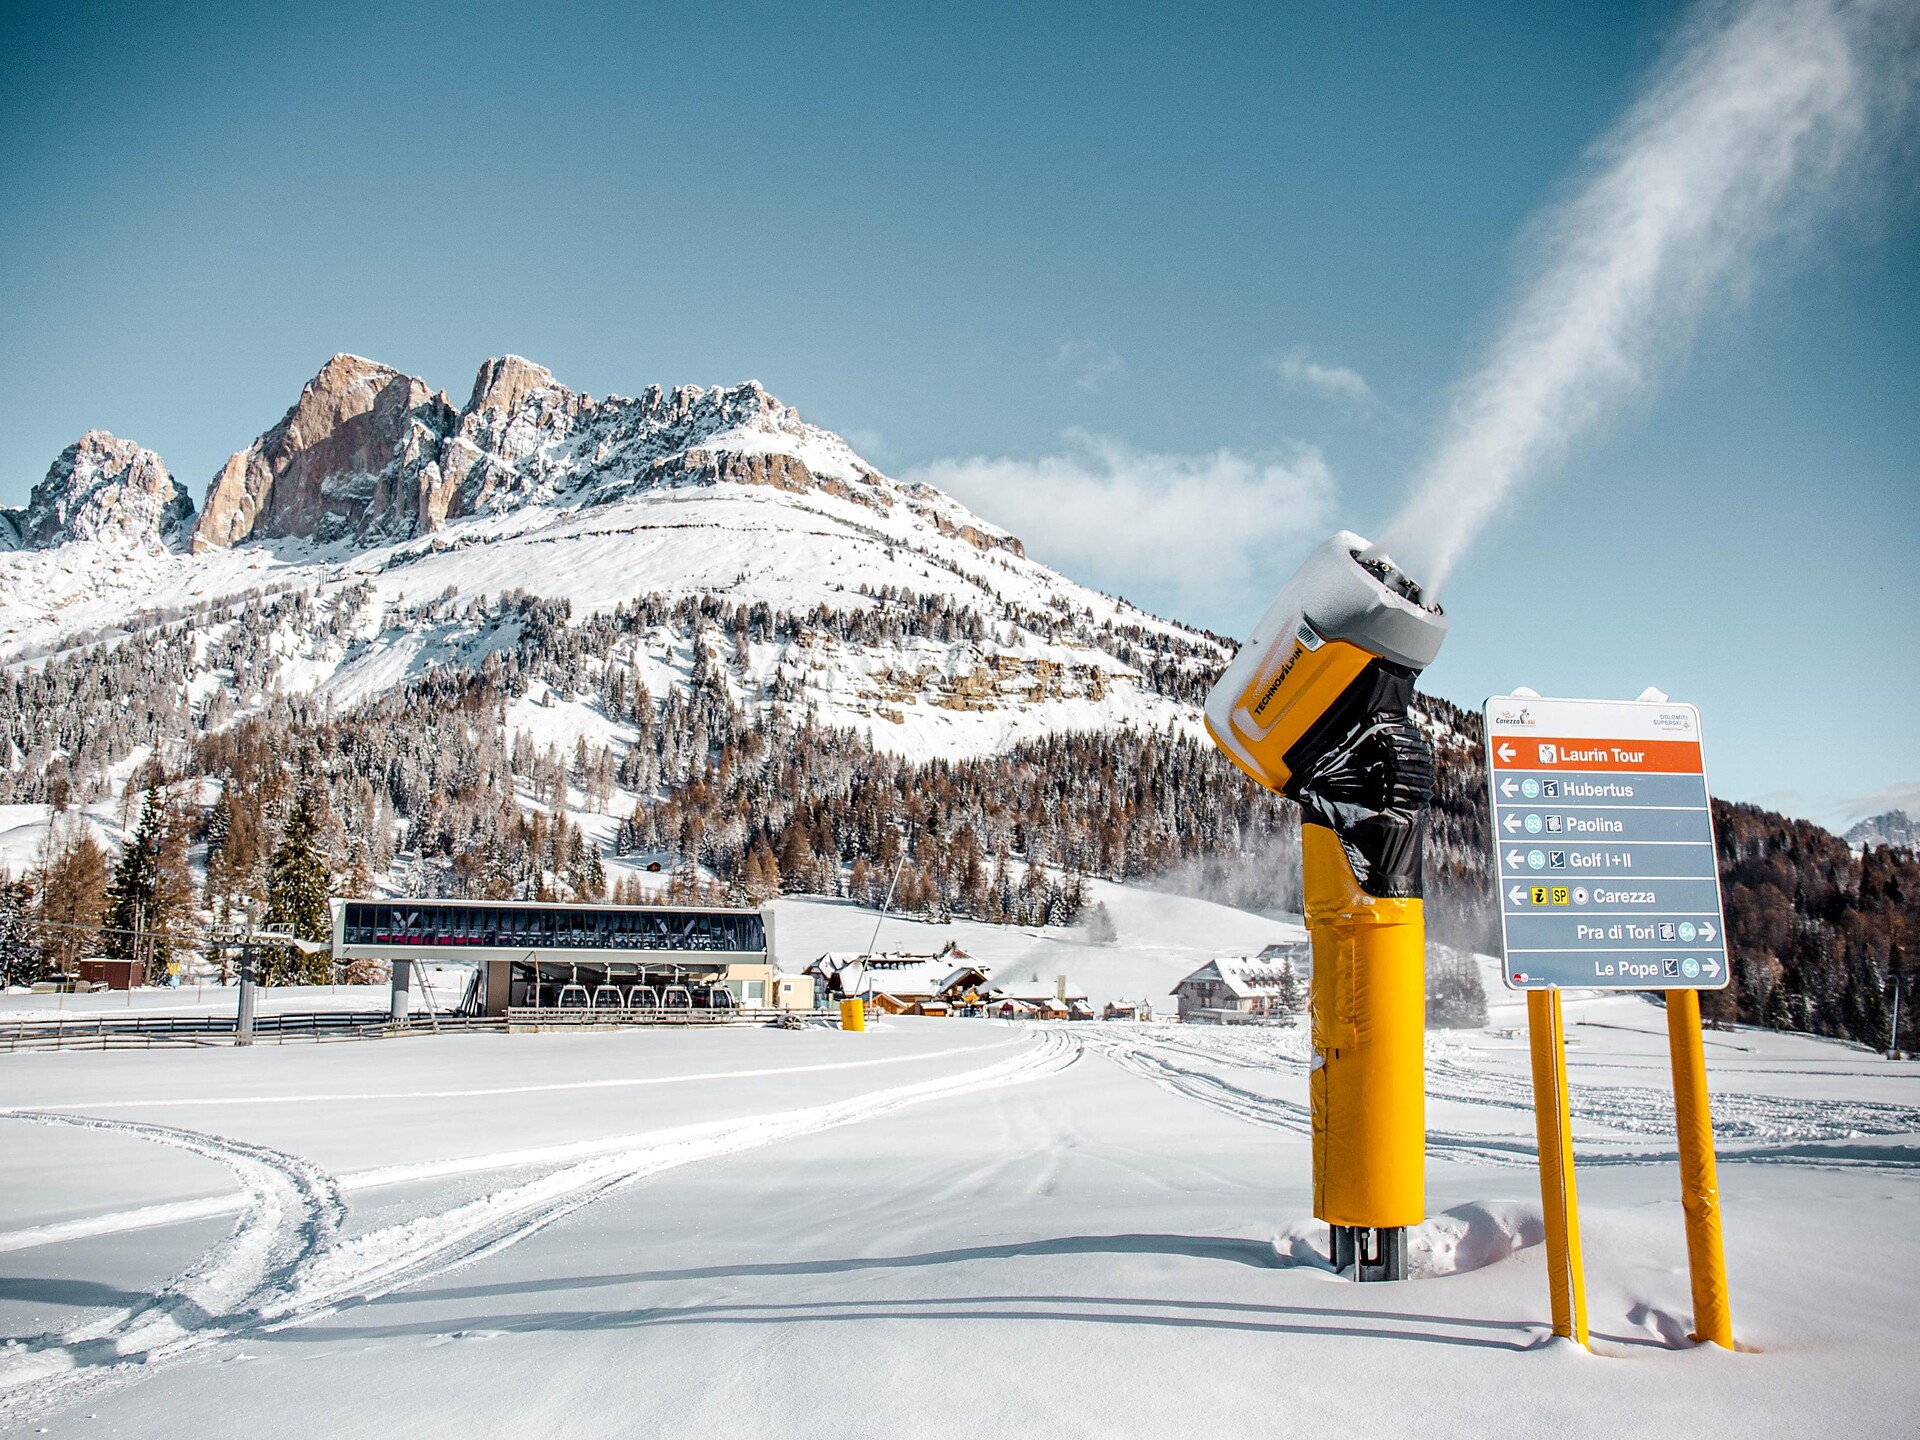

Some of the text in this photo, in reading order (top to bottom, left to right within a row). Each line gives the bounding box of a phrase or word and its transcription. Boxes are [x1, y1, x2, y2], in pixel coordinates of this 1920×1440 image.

[1560, 747, 1645, 763] Laurin Tour
[1524, 782, 1634, 797] 53 Hubertus
[1527, 817, 1623, 832] 53 Paolina
[1530, 854, 1544, 865] 53
[1569, 852, 1602, 867] Golf
[1554, 890, 1566, 902] SP
[1593, 888, 1656, 903] Carezza
[1577, 924, 1694, 939] Pra di Tori 54
[1595, 961, 1698, 979] Le Pope 54
